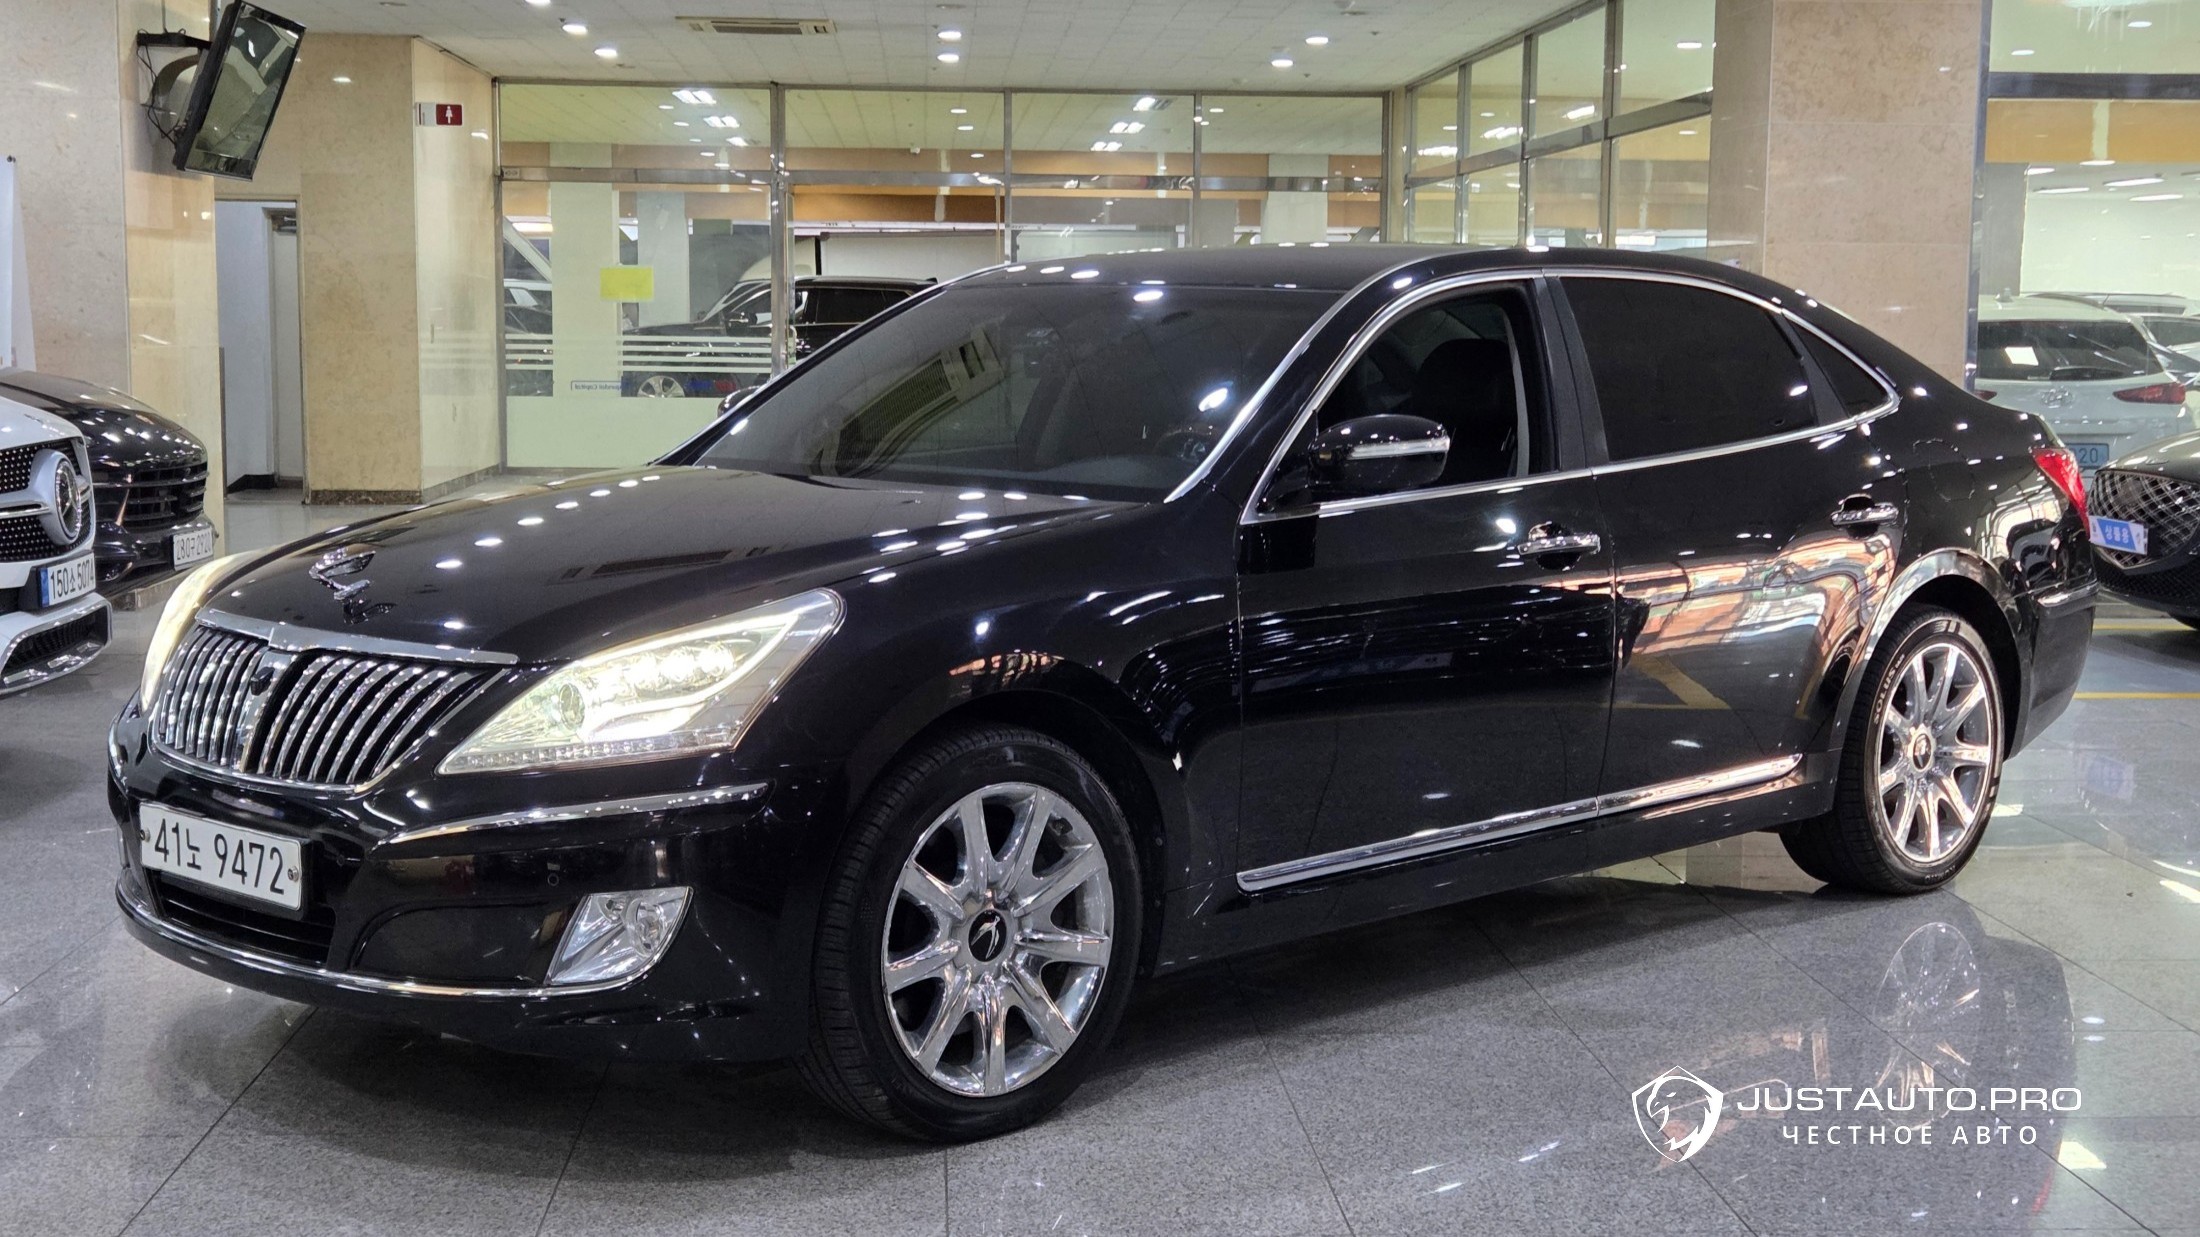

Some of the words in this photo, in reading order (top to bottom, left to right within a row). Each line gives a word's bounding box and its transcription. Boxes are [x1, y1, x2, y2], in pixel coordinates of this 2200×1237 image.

[50, 567, 76, 600] 150소
[77, 558, 95, 591] 5074
[1873, 666, 1897, 725] SOLUS
[154, 818, 202, 871] 41노
[213, 833, 285, 895] 9472
